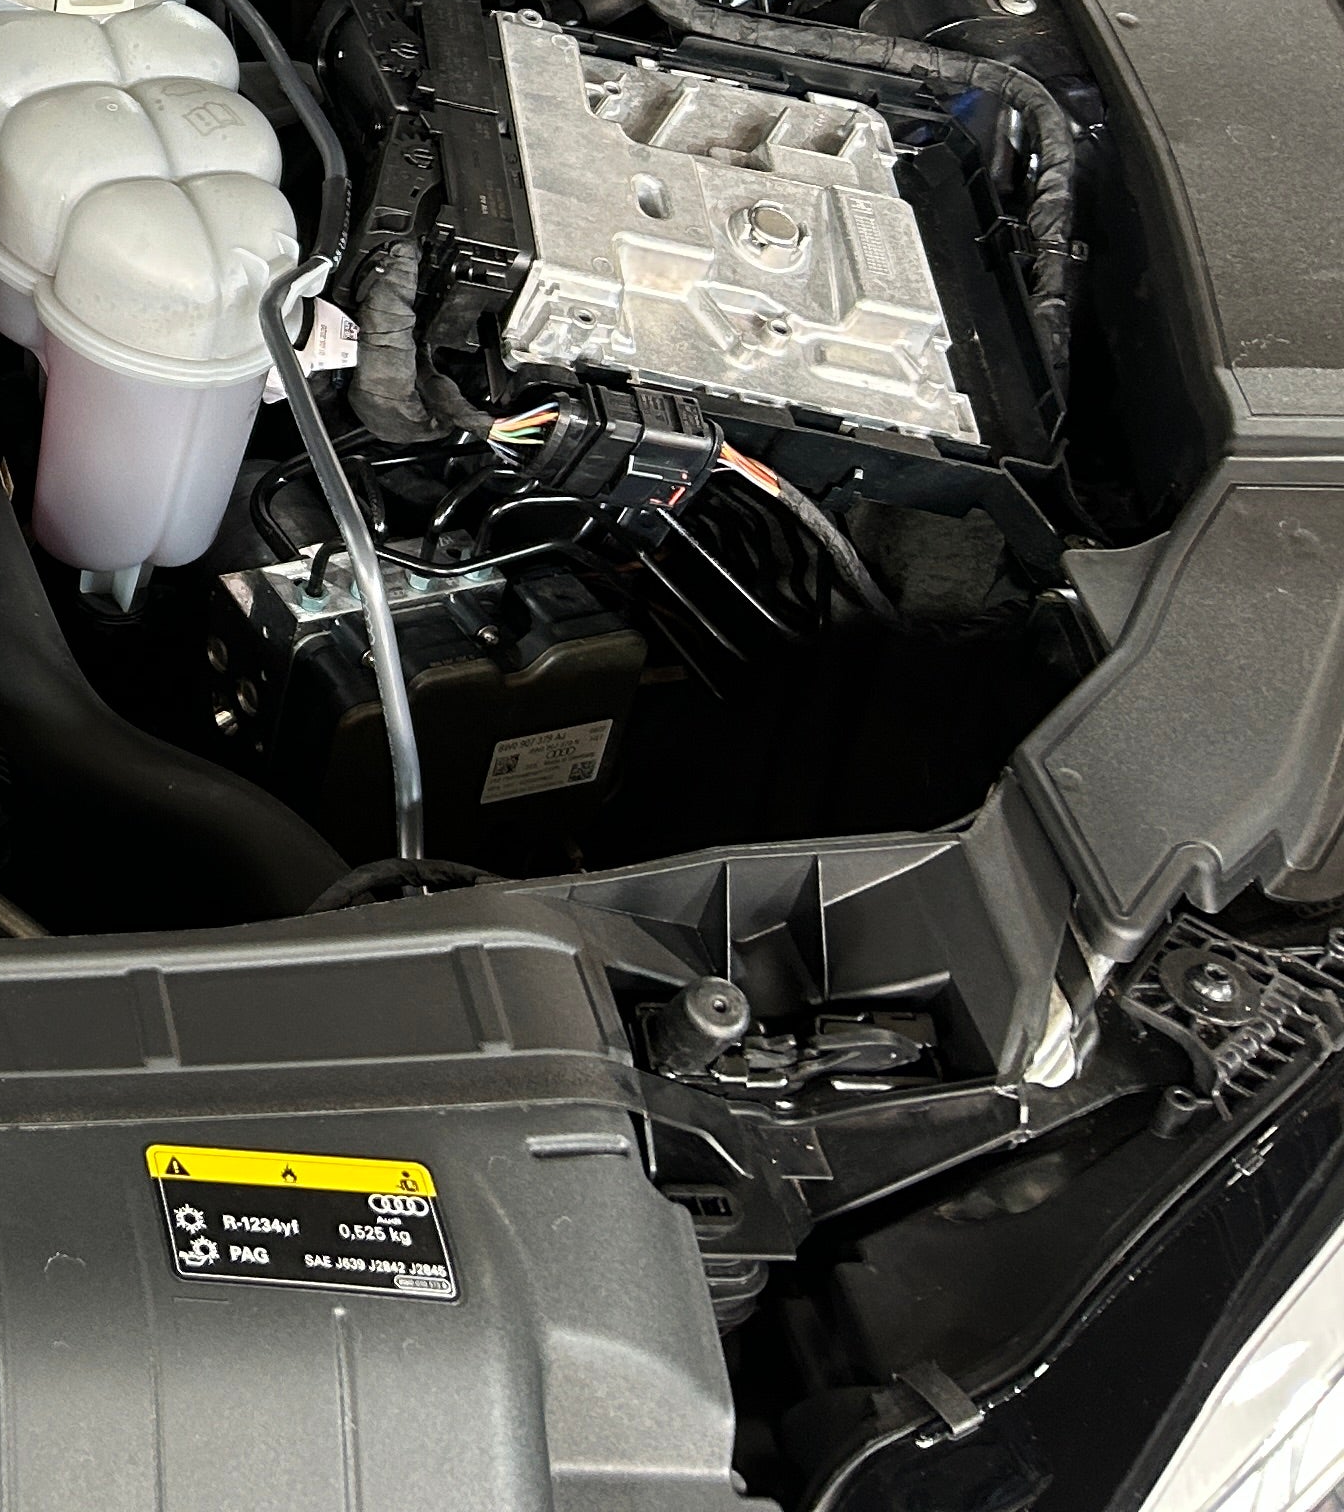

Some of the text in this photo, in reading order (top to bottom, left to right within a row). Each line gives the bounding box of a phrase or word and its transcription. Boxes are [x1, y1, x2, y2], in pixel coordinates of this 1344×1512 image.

[221, 1214, 302, 1238] R-1234yf
[337, 1223, 413, 1247] 0,525 kg
[228, 1246, 270, 1264] PAG
[303, 1254, 333, 1269] SAE
[333, 1257, 366, 1272] J639
